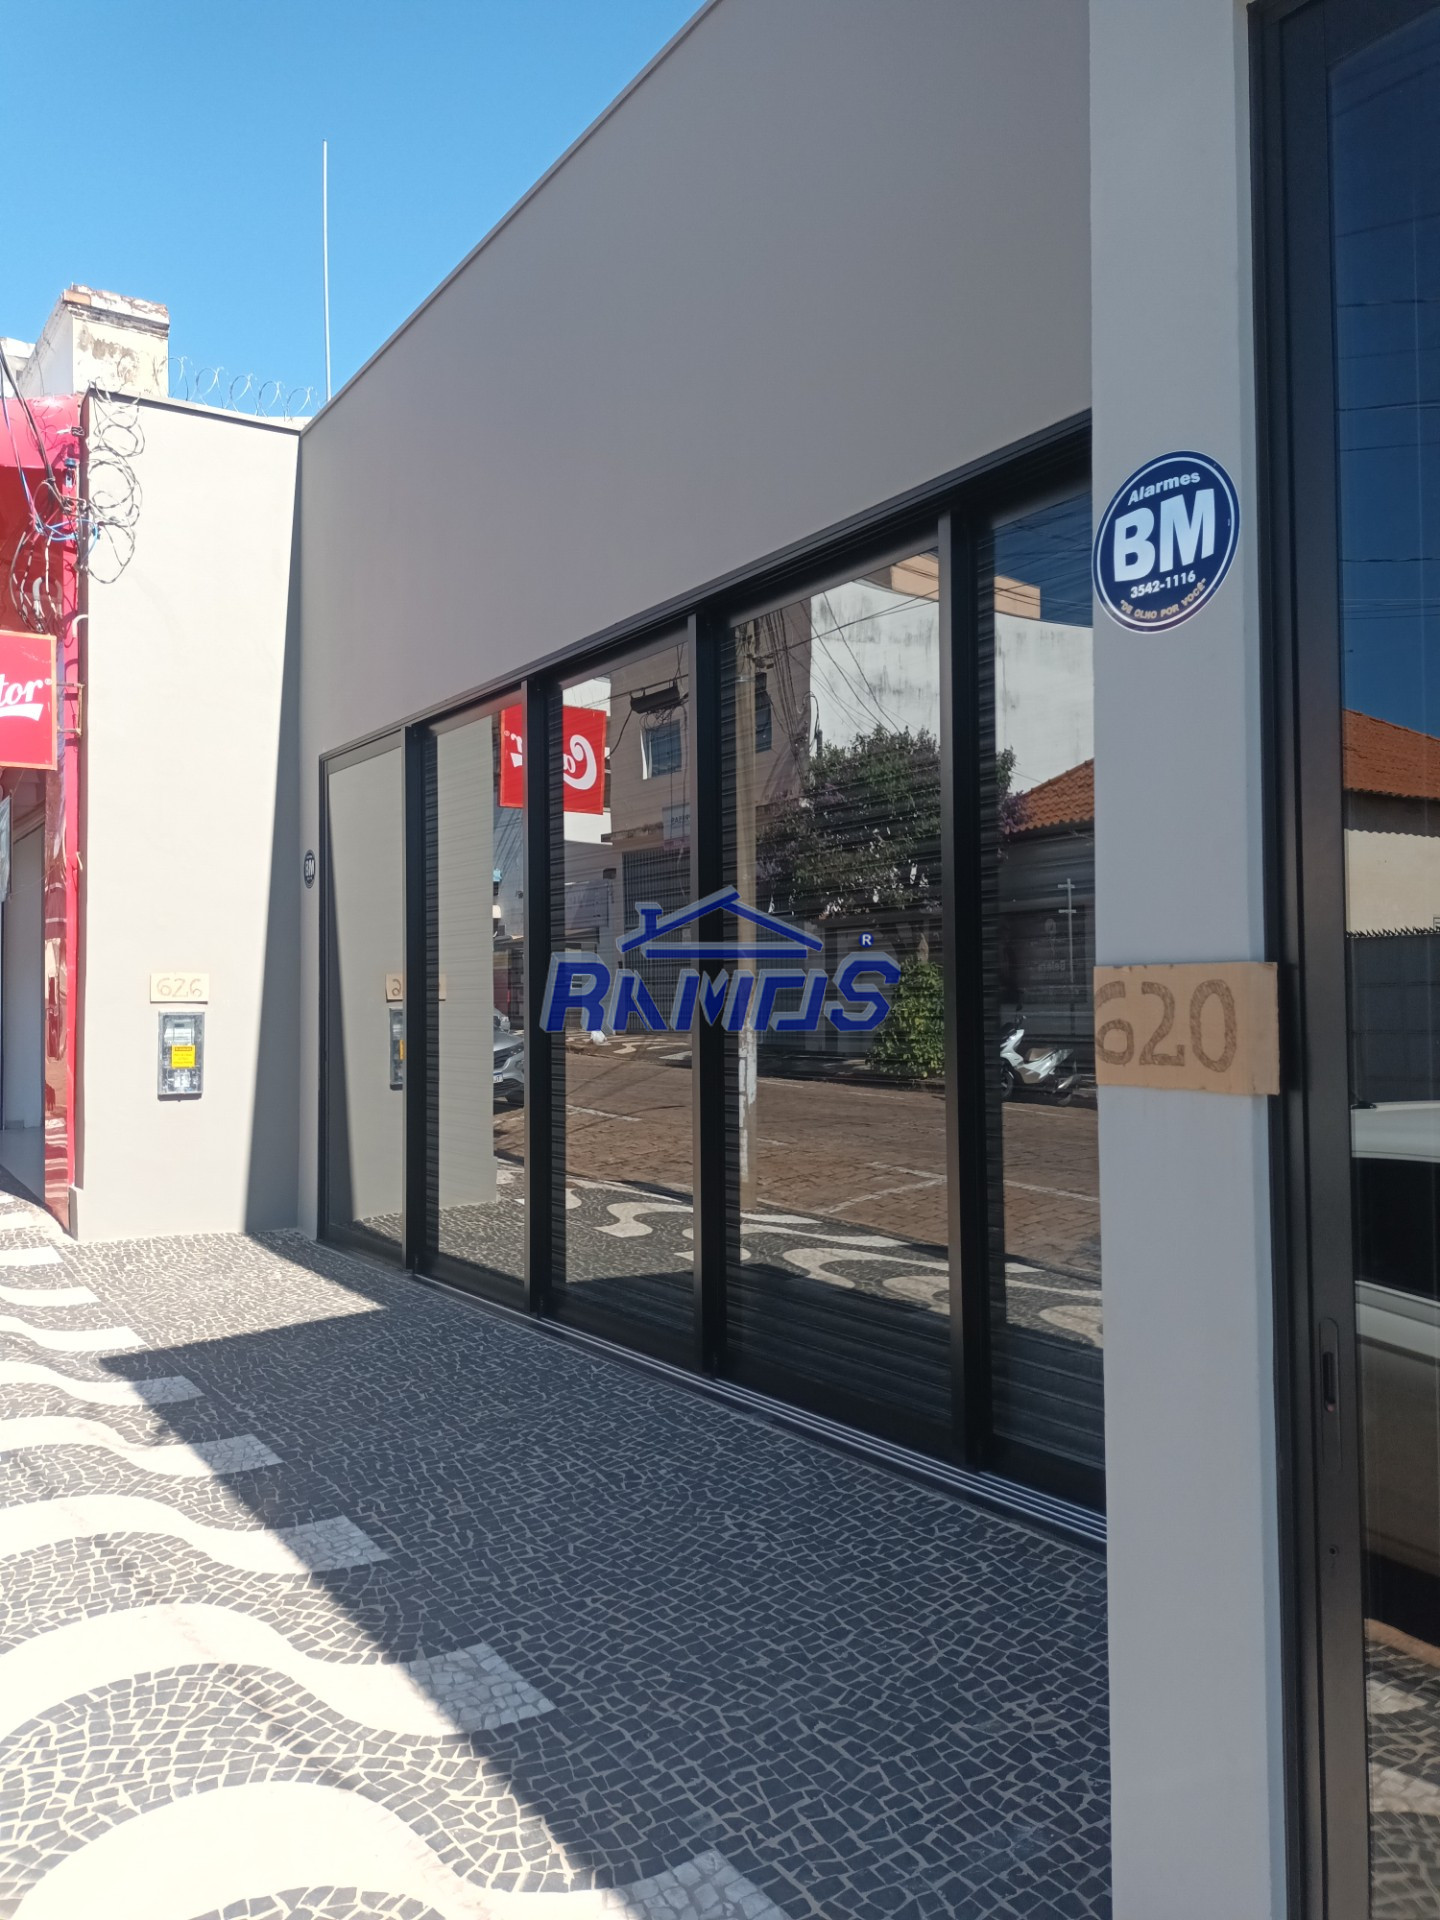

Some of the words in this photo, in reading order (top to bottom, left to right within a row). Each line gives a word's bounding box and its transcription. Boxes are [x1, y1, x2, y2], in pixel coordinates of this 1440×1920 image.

[1127, 472, 1201, 506] Alarmes
[1113, 488, 1216, 582] BM
[1130, 570, 1197, 599] 3542-1116
[1160, 603, 1180, 618] POR
[1095, 978, 1238, 1073] 620
